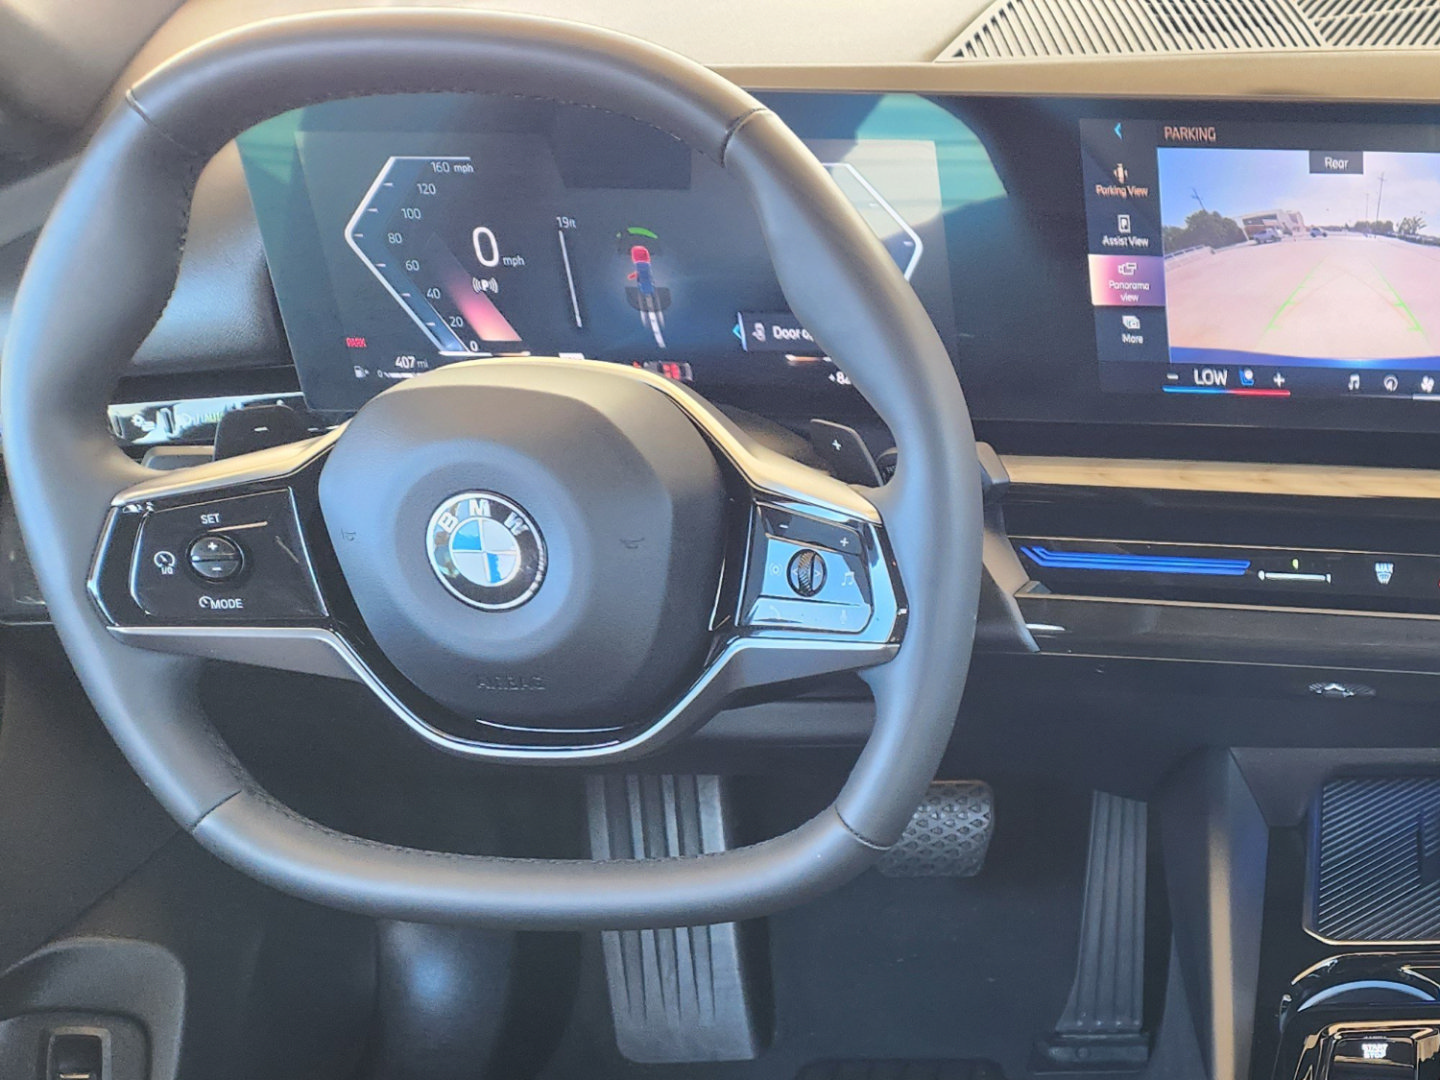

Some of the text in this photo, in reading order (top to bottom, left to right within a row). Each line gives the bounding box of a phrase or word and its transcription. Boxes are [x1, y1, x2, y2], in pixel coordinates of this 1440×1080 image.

[1164, 126, 1216, 142] PARKING
[431, 161, 474, 175] 160 mph
[1324, 155, 1349, 170] Rear
[417, 183, 436, 195] 120
[1095, 184, 1149, 199] Parking View
[401, 207, 421, 220] 100
[387, 232, 403, 244] 80
[1102, 236, 1149, 248] Assist View
[472, 226, 525, 268] 0 mph
[405, 260, 420, 271] 60
[1109, 279, 1150, 291] Panorama
[426, 288, 441, 300] 40
[1120, 292, 1139, 302] view
[449, 315, 464, 328] 20
[772, 325, 801, 340] Door
[1121, 333, 1144, 345] More
[469, 341, 479, 353] 0
[395, 355, 429, 369] 407 mi
[1193, 368, 1228, 386] LOW
[200, 512, 221, 525] SET
[438, 498, 529, 536] BMW
[210, 597, 243, 610] MODE
